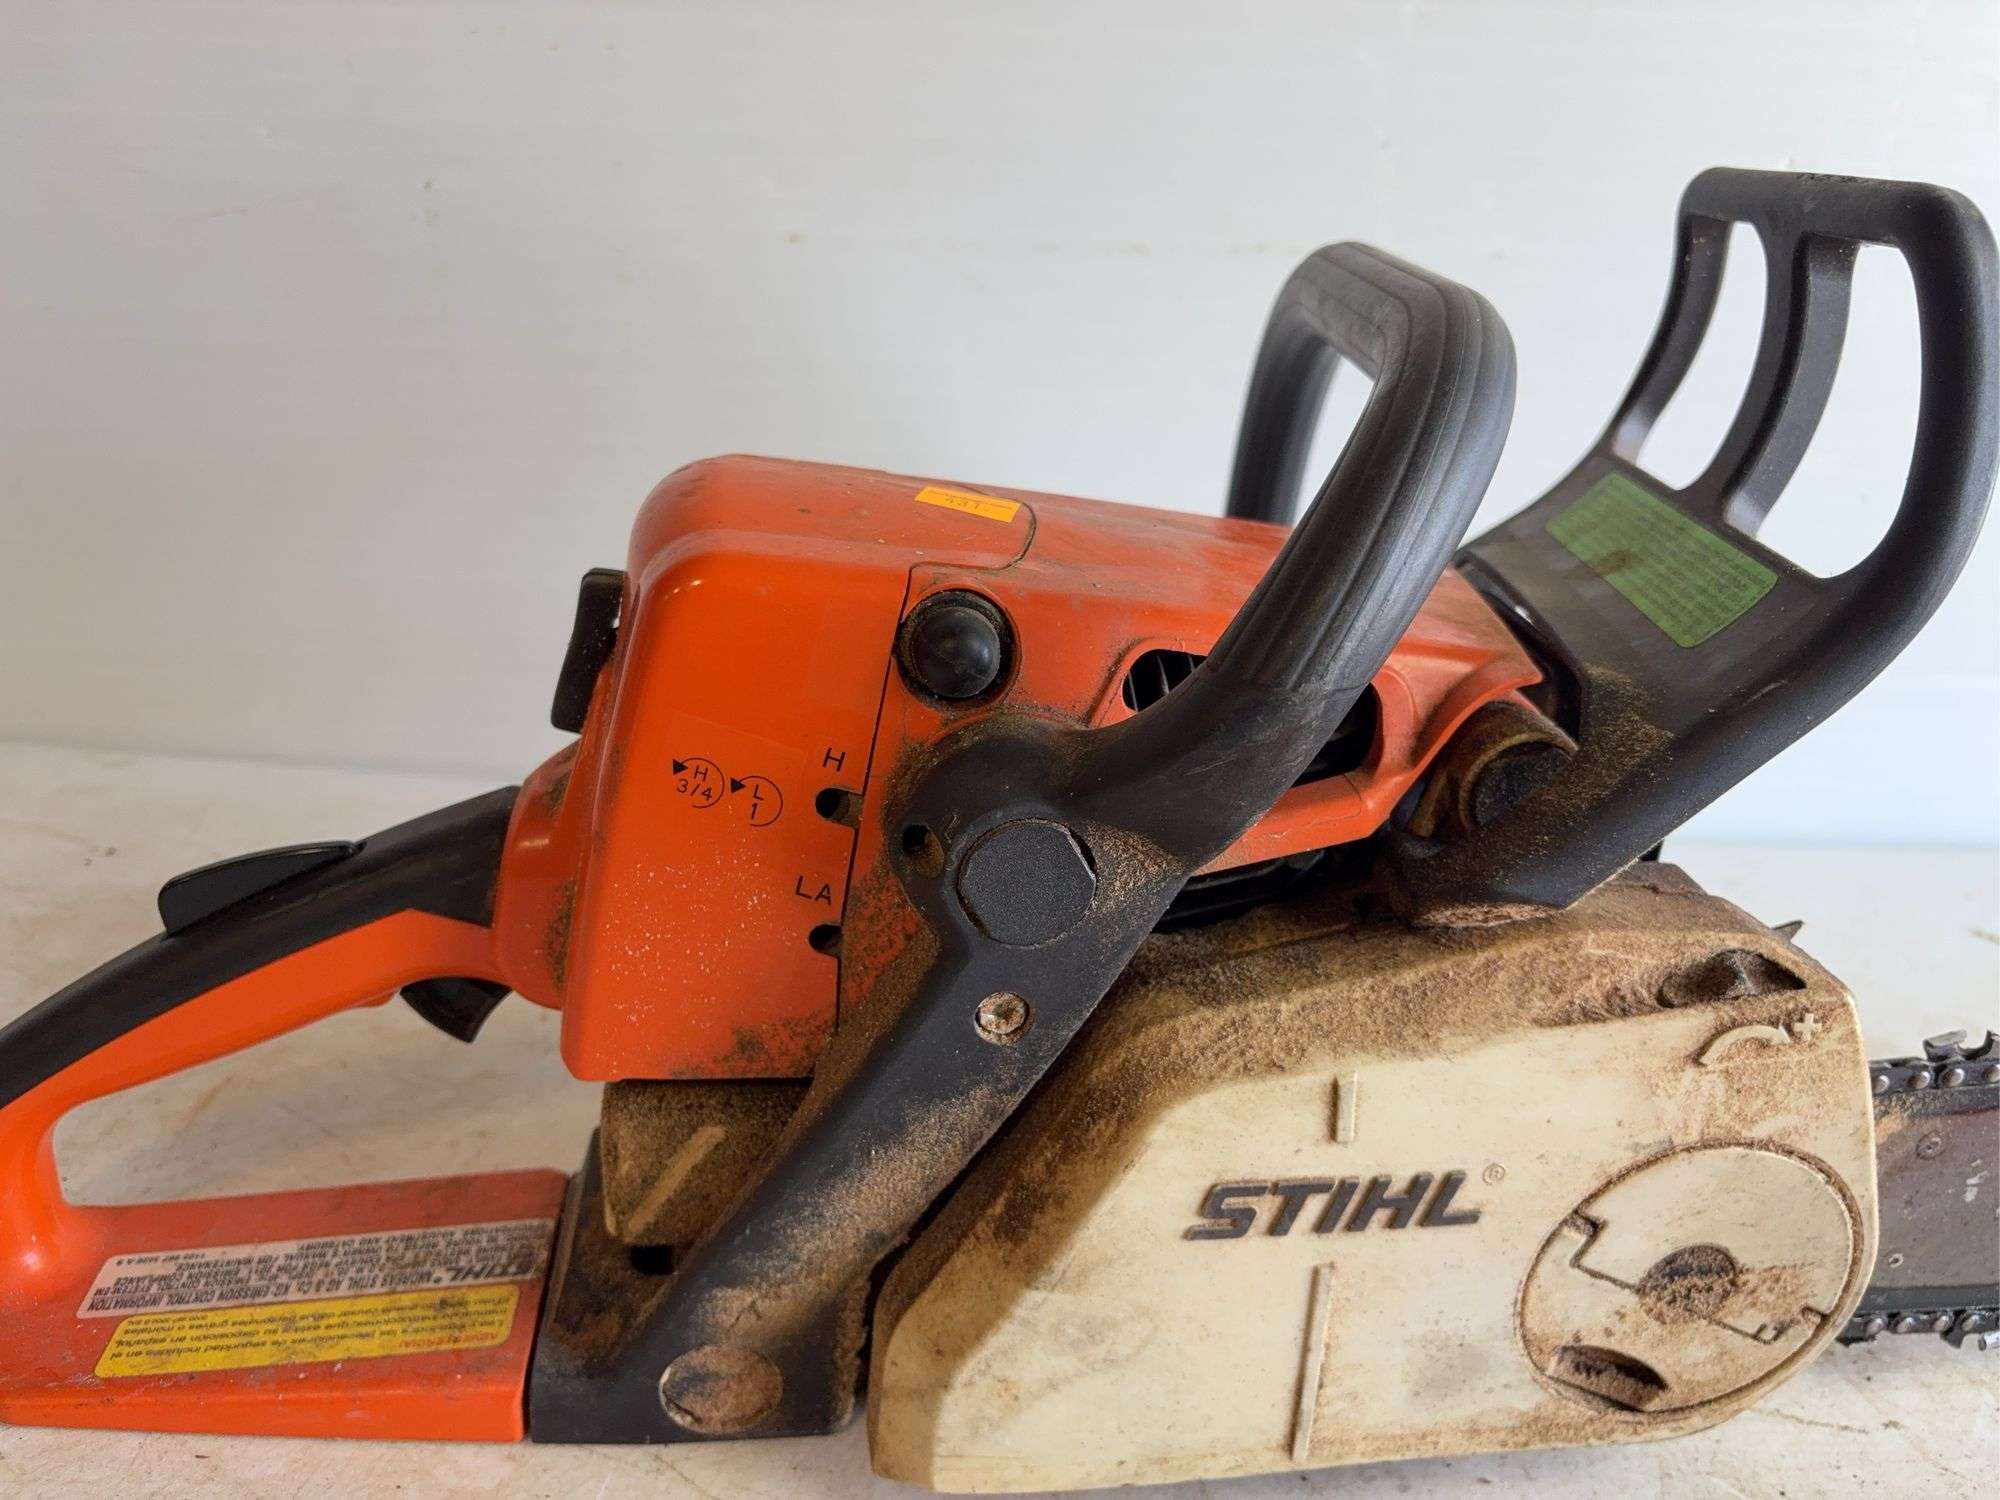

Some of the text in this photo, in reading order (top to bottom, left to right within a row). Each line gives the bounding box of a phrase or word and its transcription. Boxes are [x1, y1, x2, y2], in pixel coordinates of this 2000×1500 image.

[822, 748, 846, 771] H
[693, 765, 709, 782] H
[676, 778, 713, 802] 3/4
[753, 784, 765, 801] L
[795, 875, 833, 905] LA
[1181, 1169, 1482, 1242] STIHL
[165, 1289, 216, 1305] CONTROL
[216, 1285, 271, 1302] EMISSION
[87, 1294, 163, 1311] INFORMATION
